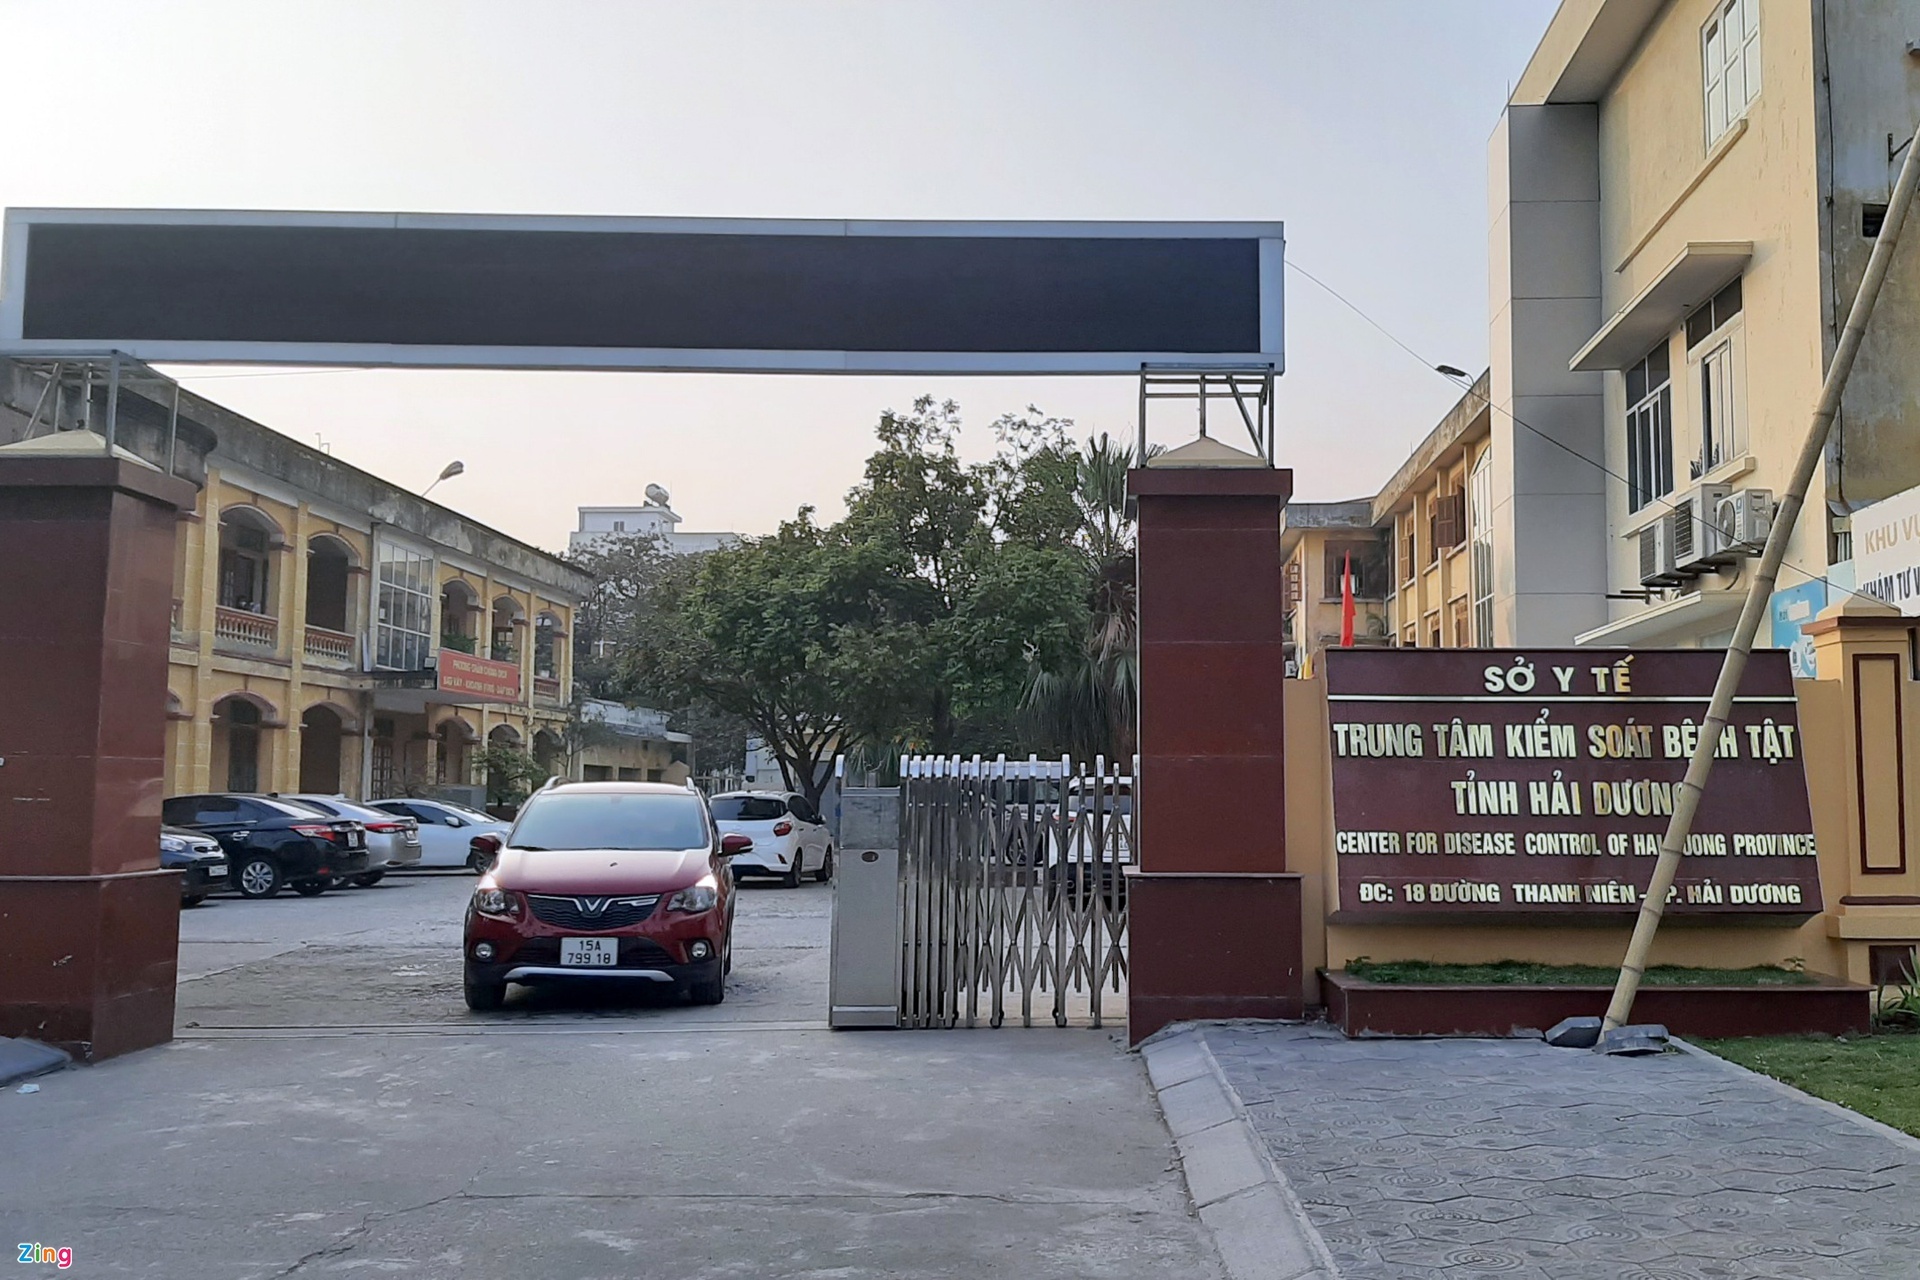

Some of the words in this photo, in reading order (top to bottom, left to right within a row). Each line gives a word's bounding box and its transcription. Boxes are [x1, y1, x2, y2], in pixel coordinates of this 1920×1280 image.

[1865, 521, 1898, 555] KHU
[1896, 566, 1911, 601] TƯ
[1484, 656, 1535, 693] SỞ
[1552, 666, 1575, 692] Y
[1590, 654, 1635, 693] TẾ
[1333, 723, 1423, 757] TRUNG
[1433, 717, 1494, 758] TÂM
[1505, 708, 1576, 758] KIỂM
[1587, 717, 1653, 758] SOÁT
[1662, 718, 1739, 764] BỆH
[1745, 718, 1795, 764] TẬT
[1451, 770, 1519, 815] TỈNH
[1529, 770, 1581, 815] HẢI
[1593, 778, 1684, 816] DƯƠN
[1336, 831, 1400, 854] CENTER
[1406, 832, 1438, 854] FOR
[1443, 832, 1516, 855] DISEASE
[1524, 833, 1601, 855] CONTROL
[1607, 834, 1628, 855] OF
[1682, 834, 1727, 856] UONG
[1733, 834, 1816, 856] PROVINCE
[1359, 883, 1394, 902] ĐC:
[1403, 884, 1425, 902] 18
[1430, 880, 1500, 902] ĐƯỜNG
[1512, 884, 1580, 902] THANH
[1584, 881, 1636, 903] NIÊN
[1687, 879, 1723, 903] HẢI
[1730, 883, 1801, 903] DƯƠNG
[579, 940, 602, 951] 15A
